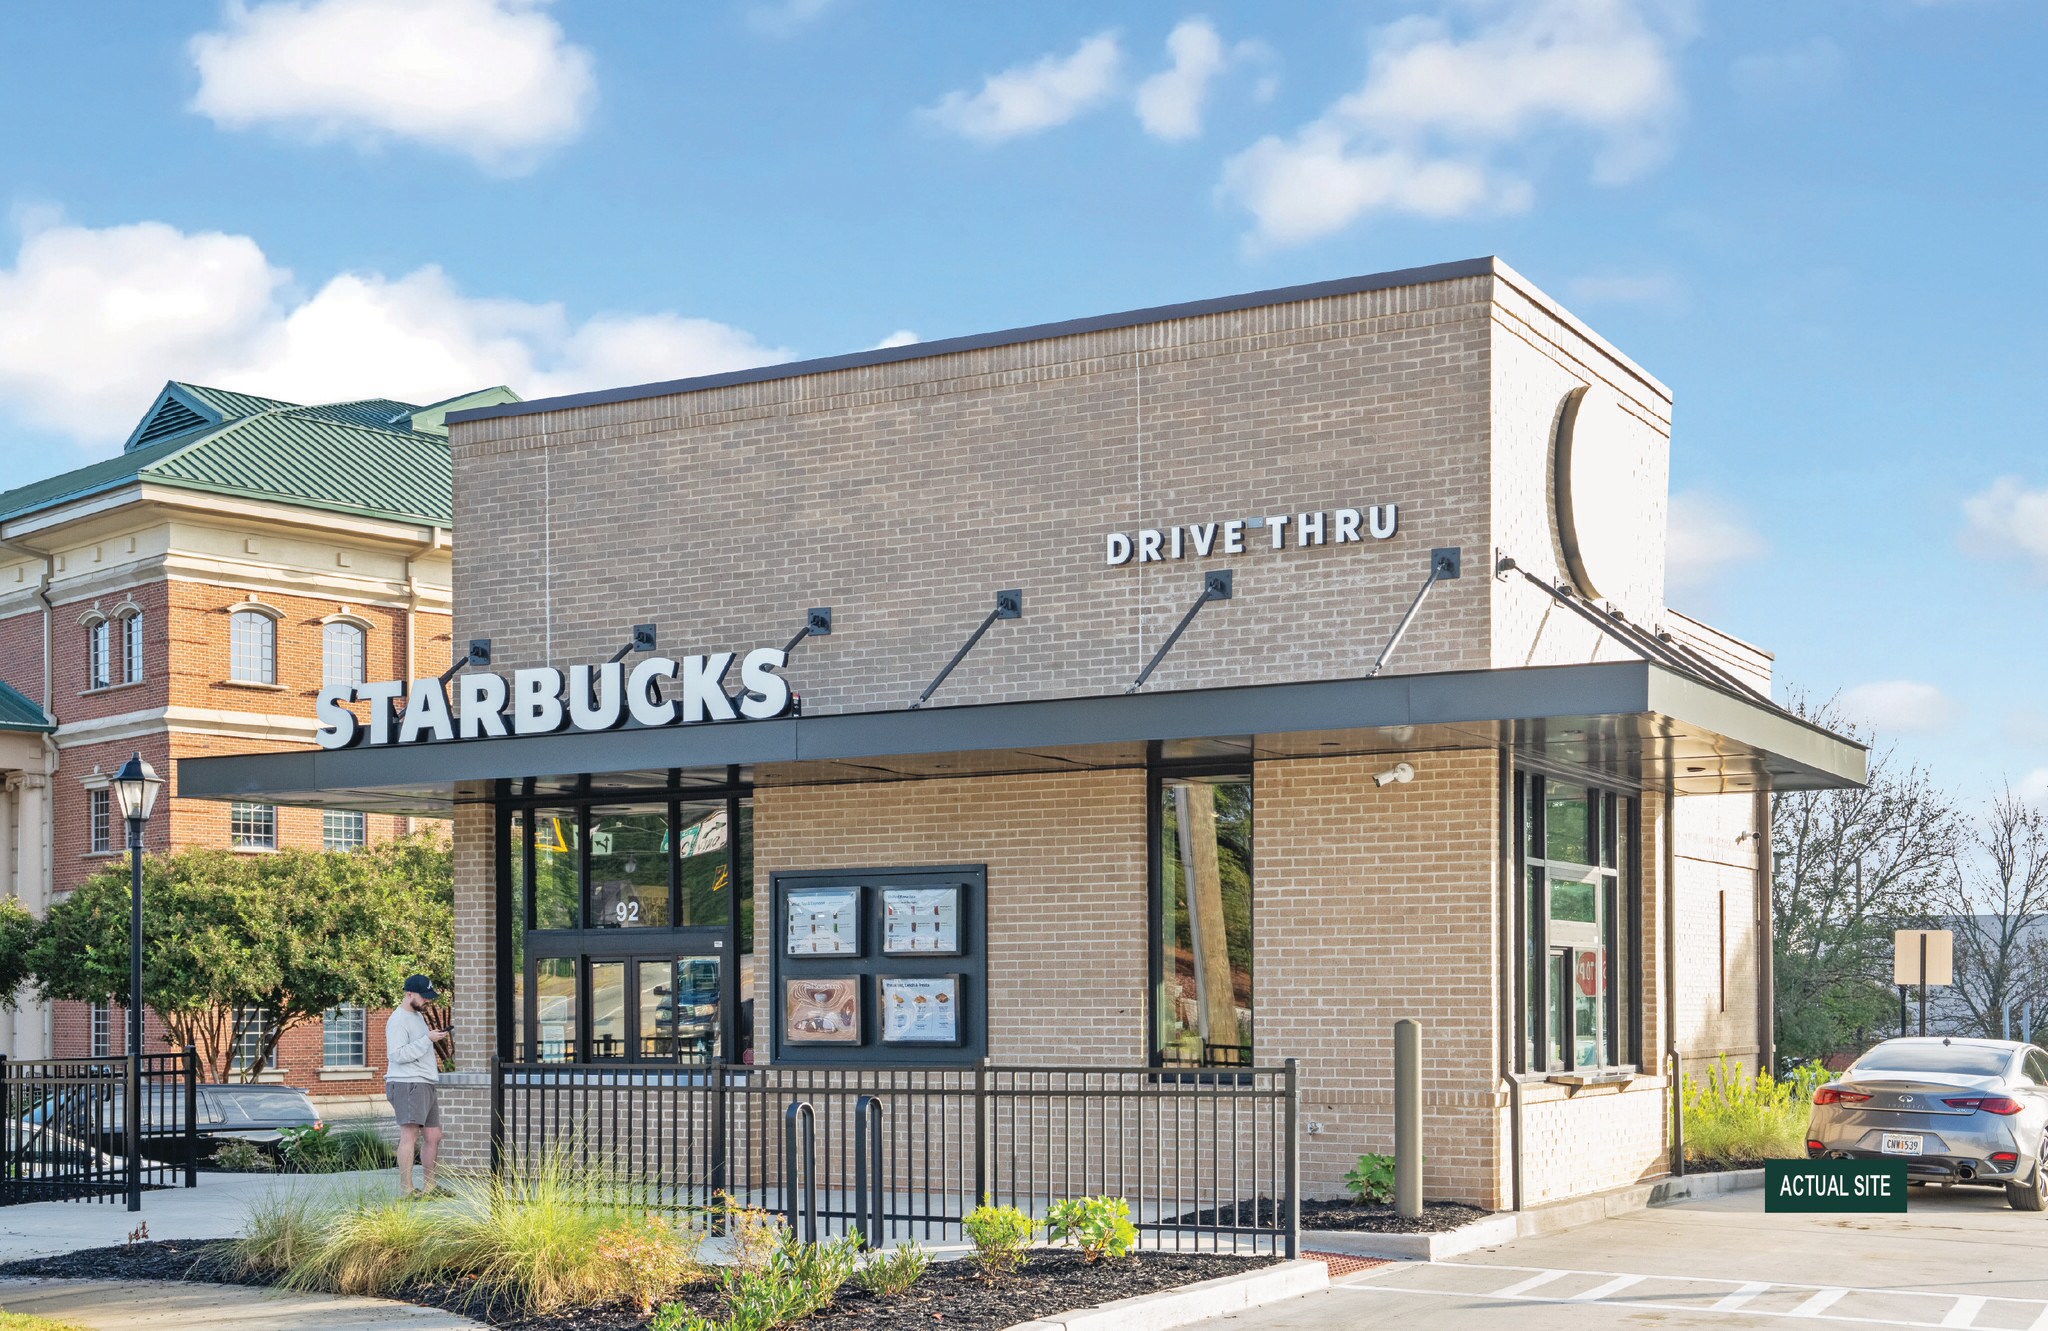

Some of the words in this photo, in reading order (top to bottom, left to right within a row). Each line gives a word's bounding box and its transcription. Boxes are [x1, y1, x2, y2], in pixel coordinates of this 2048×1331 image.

[1106, 520, 1247, 566] DRIVE
[1265, 503, 1399, 550] THRU
[315, 647, 792, 750] STARBUCKS
[616, 901, 639, 922] 92
